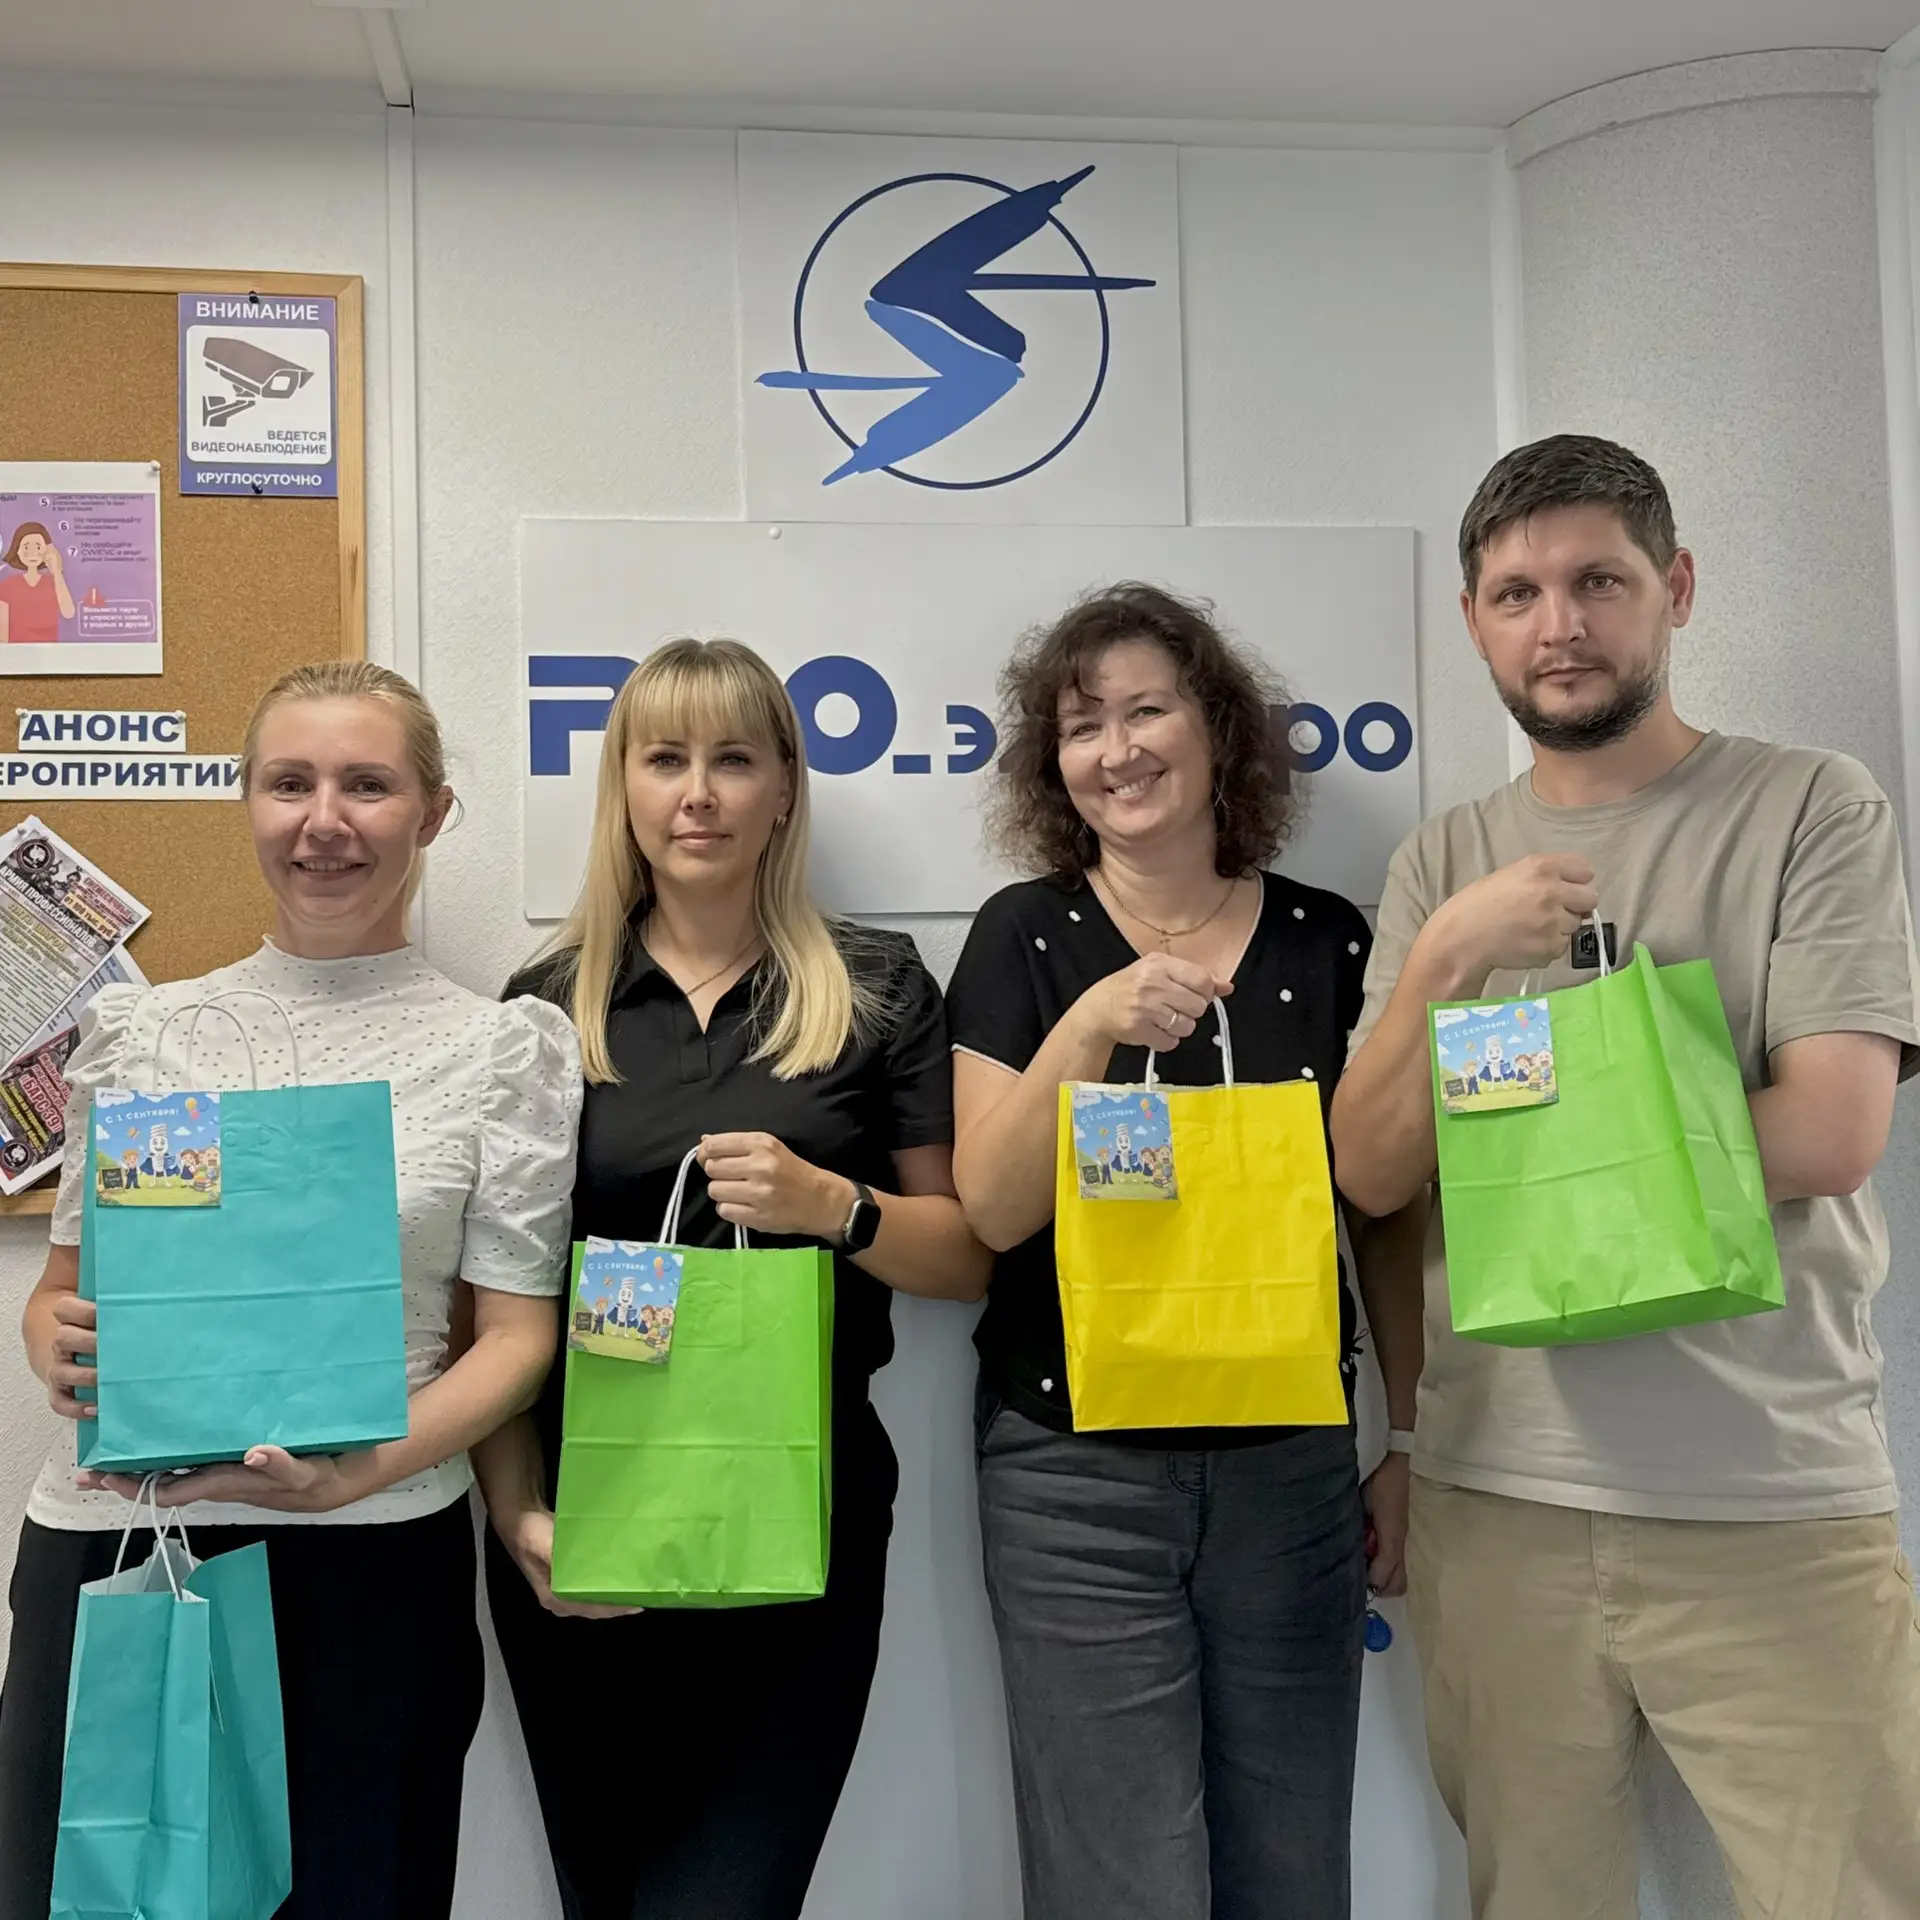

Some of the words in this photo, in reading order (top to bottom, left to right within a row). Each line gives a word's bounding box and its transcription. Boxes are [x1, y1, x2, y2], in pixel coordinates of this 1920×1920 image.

[196, 301, 319, 321] ВНИМАНИЕ
[267, 430, 327, 442] ВЕДЕТСЯ
[191, 441, 327, 455] ВИДЕОНАБЛЮДЕНИЕ
[196, 472, 322, 486] КРУГЛОСУТОЧНО
[21, 714, 181, 743] АНОНС
[0, 757, 242, 787] РОПРИЯТИЙ
[0, 864, 28, 893] АРМИЯ
[25, 884, 98, 948] ПРОФЕССИОНАЛОВ
